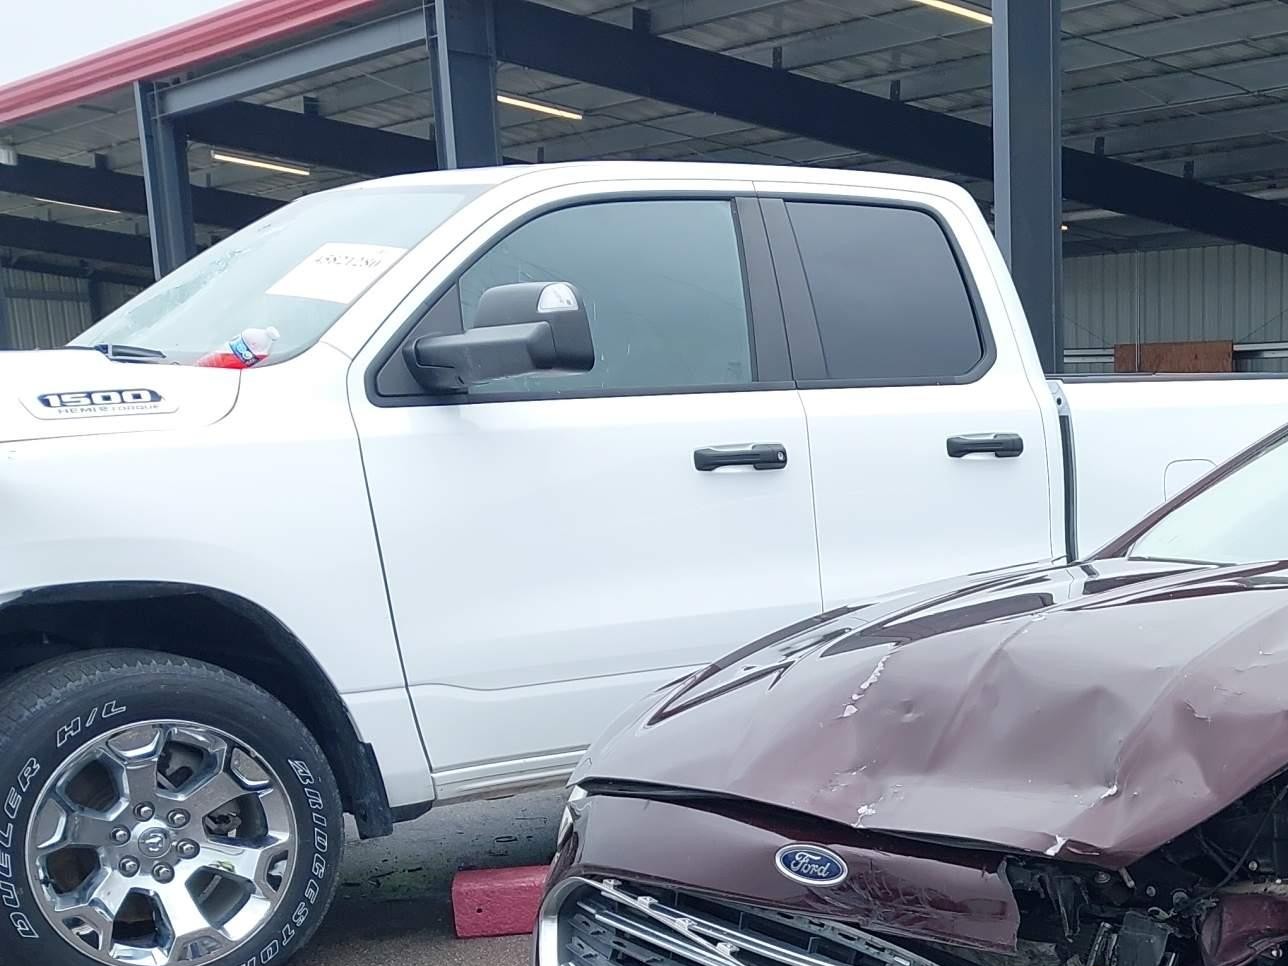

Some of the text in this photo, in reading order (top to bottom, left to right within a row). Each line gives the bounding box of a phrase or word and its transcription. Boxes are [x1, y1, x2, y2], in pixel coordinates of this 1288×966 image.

[43, 389, 153, 408] 1500
[56, 700, 127, 748] H/L
[0, 756, 41, 939] DUELER
[790, 851, 831, 878] Ford
